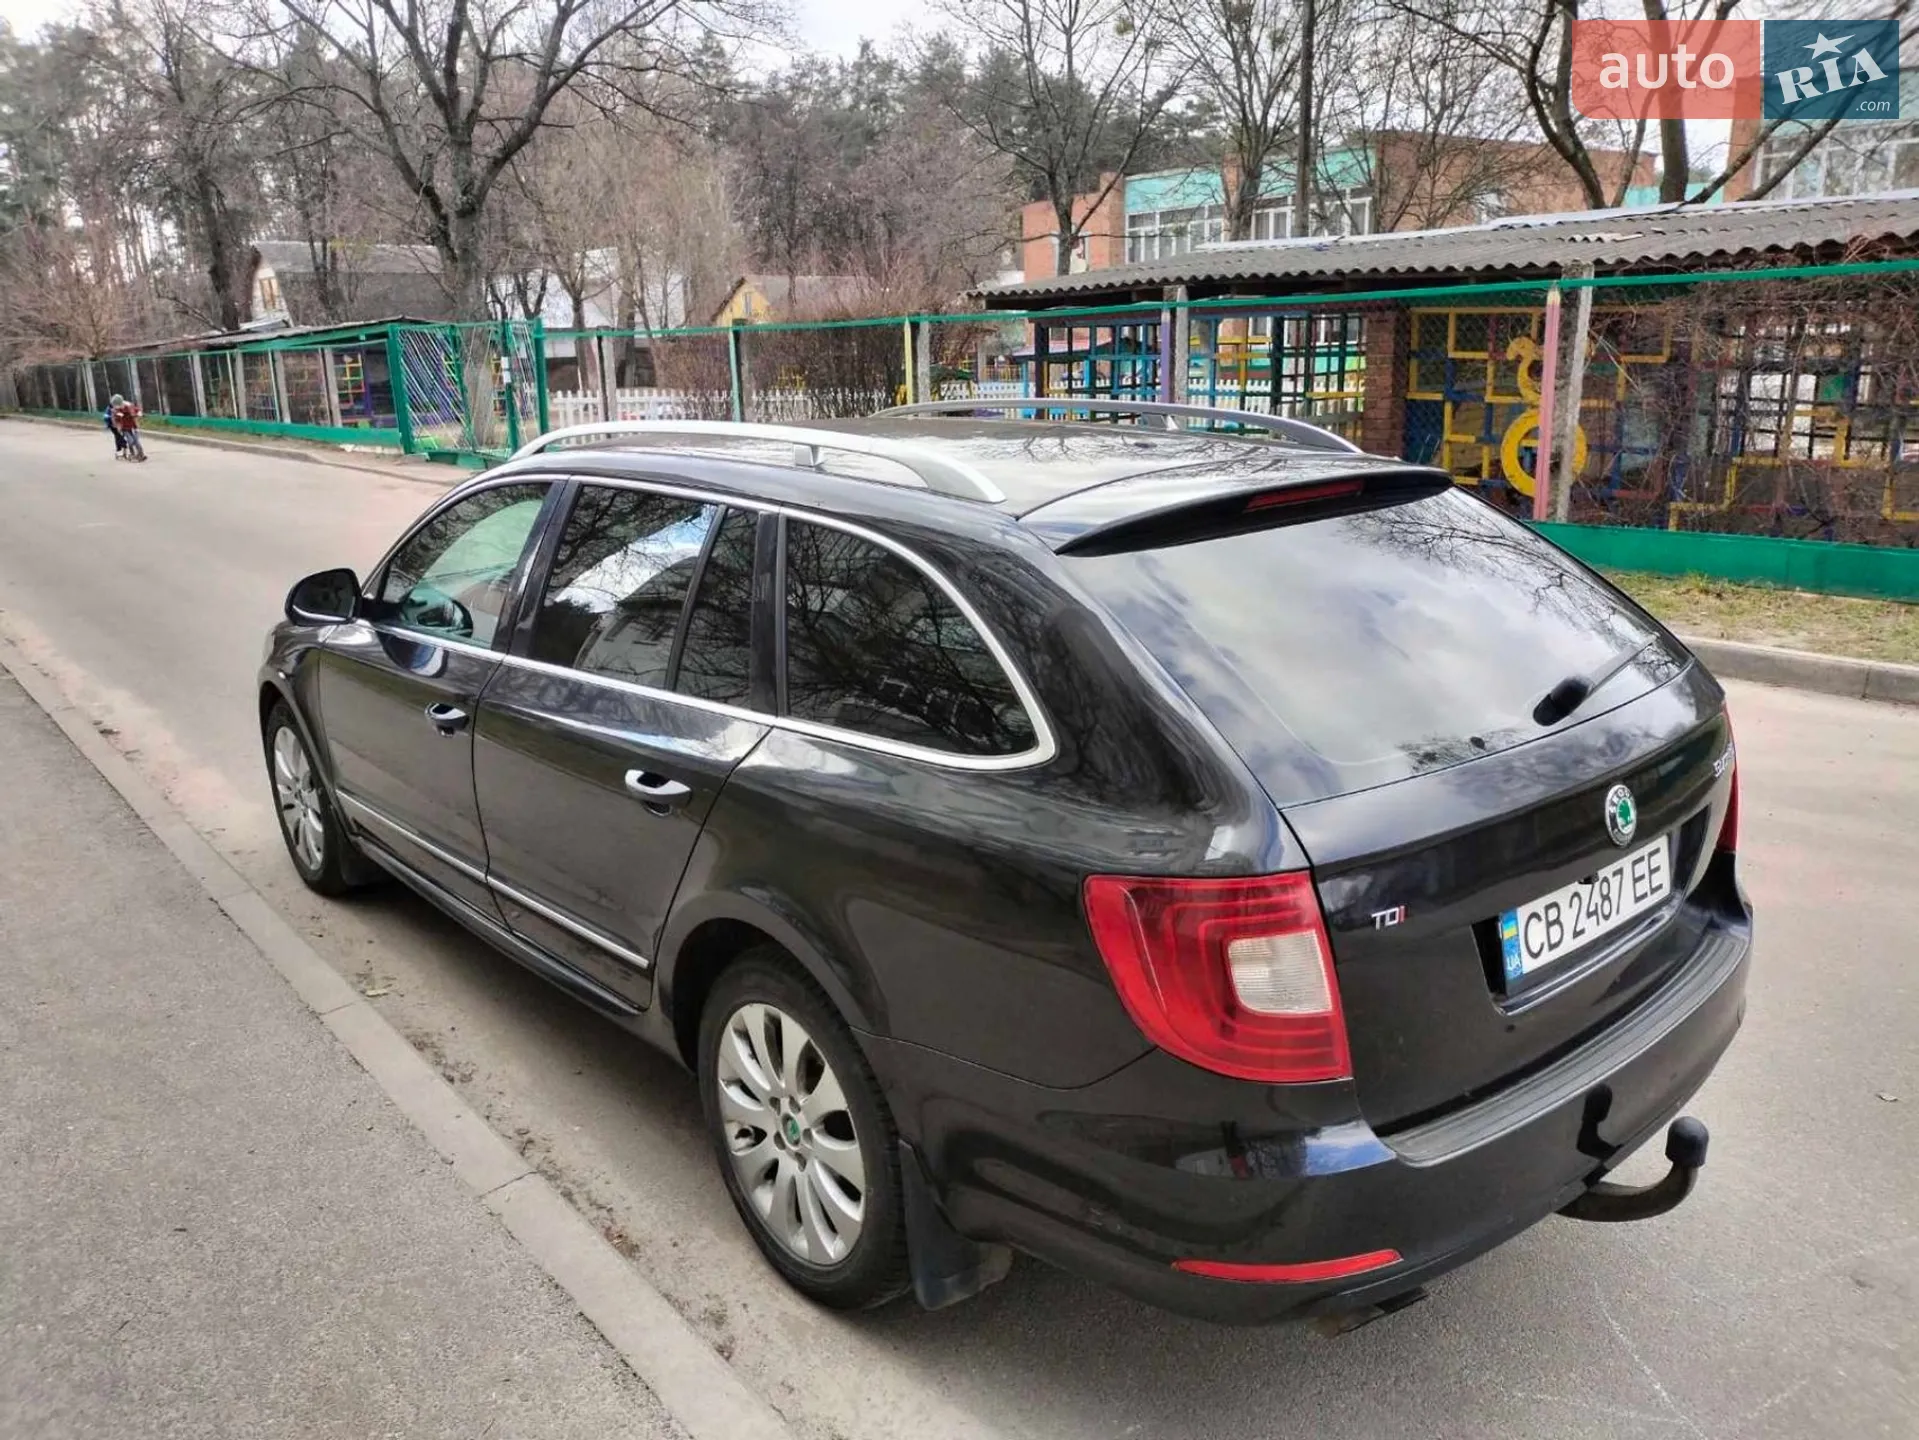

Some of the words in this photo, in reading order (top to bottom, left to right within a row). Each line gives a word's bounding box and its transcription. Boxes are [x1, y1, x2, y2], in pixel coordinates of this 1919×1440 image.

[1524, 901, 1564, 959] CB
[1569, 866, 1624, 940] 2487
[1631, 847, 1663, 904] EE
